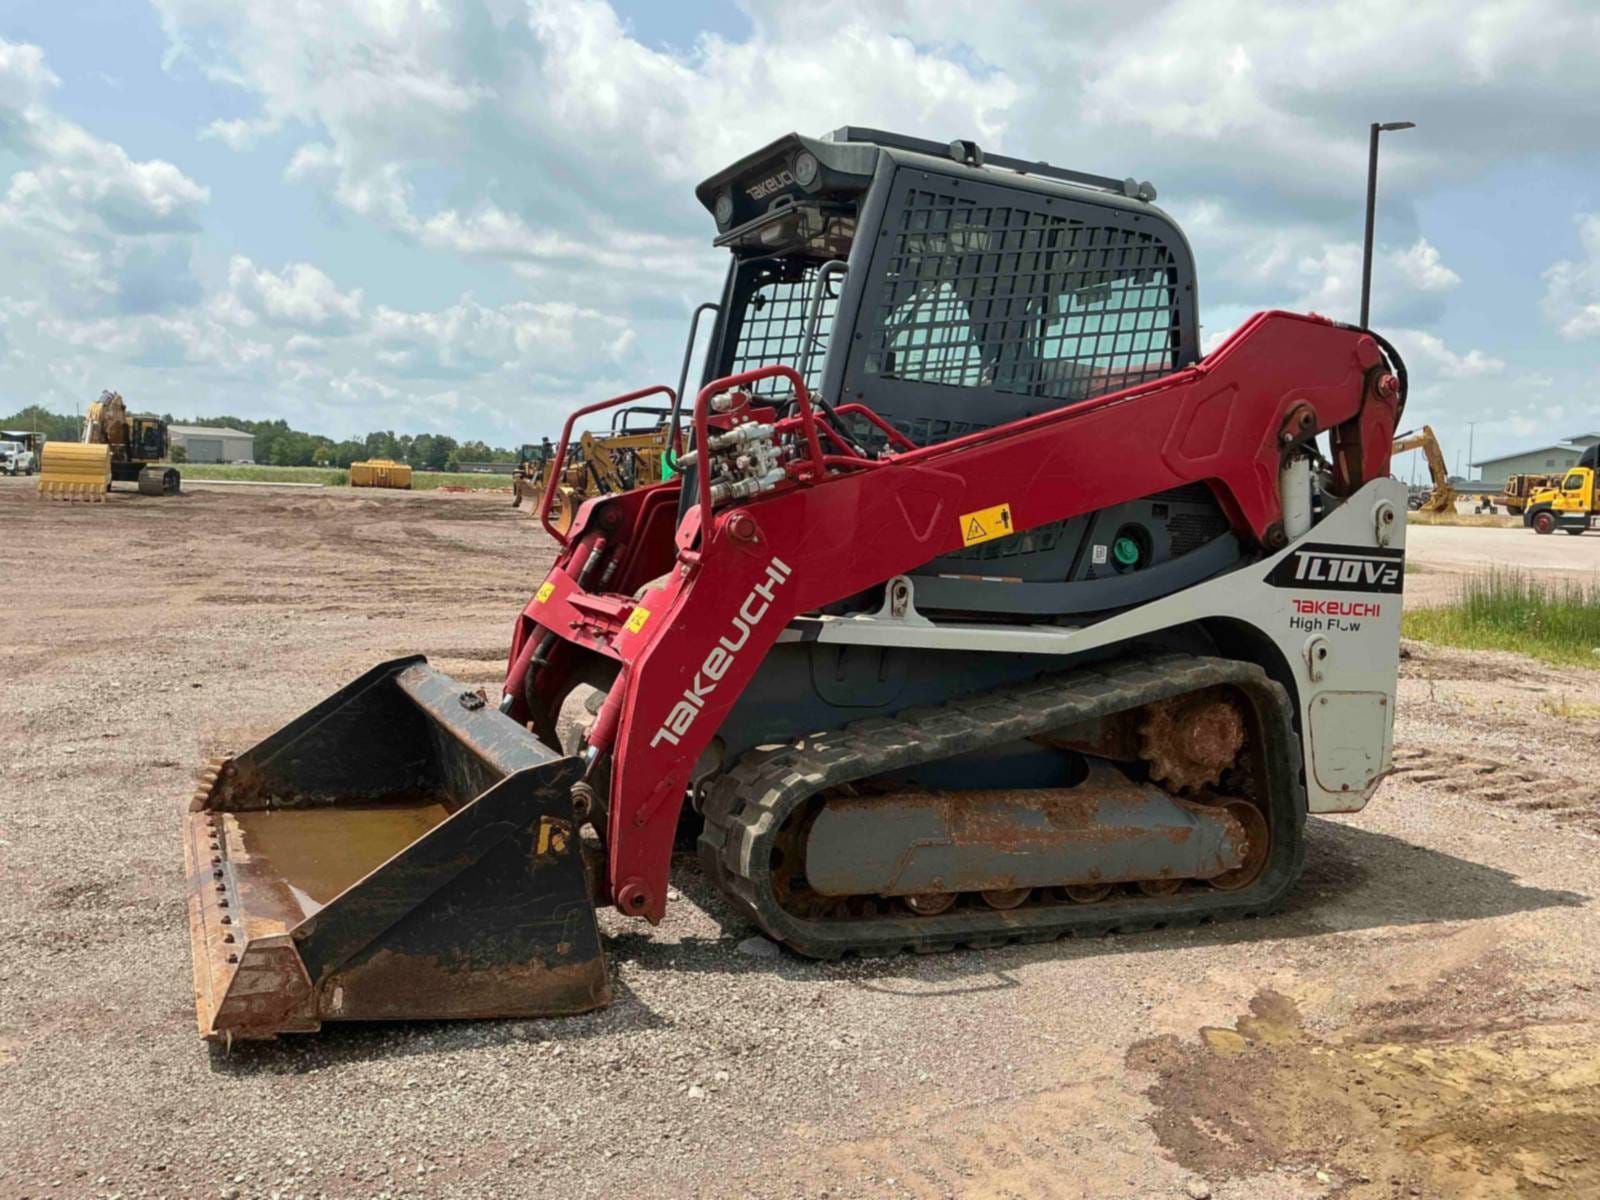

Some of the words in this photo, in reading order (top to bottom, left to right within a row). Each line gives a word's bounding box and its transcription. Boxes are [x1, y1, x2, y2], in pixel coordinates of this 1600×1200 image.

[745, 170, 794, 200] TAKEUC
[1294, 551, 1402, 586] TL10V2
[1292, 600, 1380, 617] TAKEUCHI
[1289, 616, 1323, 633] High
[650, 556, 792, 748] TAKEUCHI
